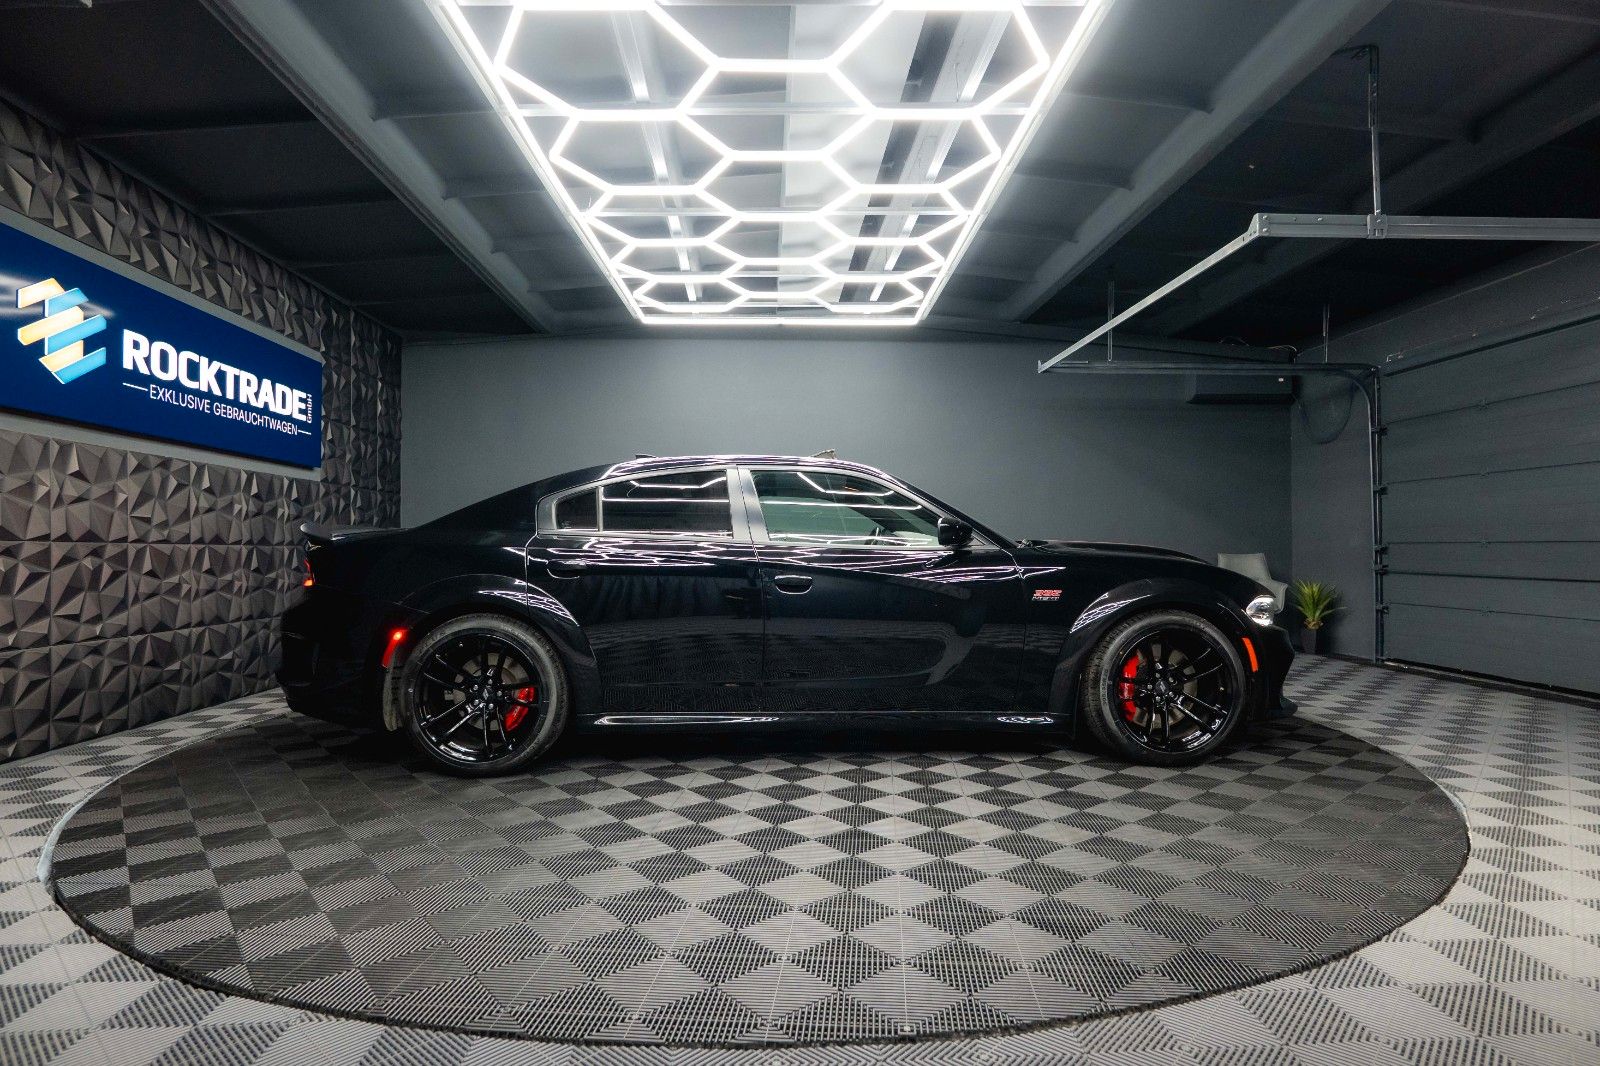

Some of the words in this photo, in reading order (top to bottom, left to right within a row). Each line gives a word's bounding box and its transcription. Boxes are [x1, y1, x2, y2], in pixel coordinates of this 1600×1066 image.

[123, 329, 307, 422] ROCKTRADE
[149, 384, 211, 414] EXKLUSIVE
[213, 402, 298, 436] GEBRAUCHTWAGEN
